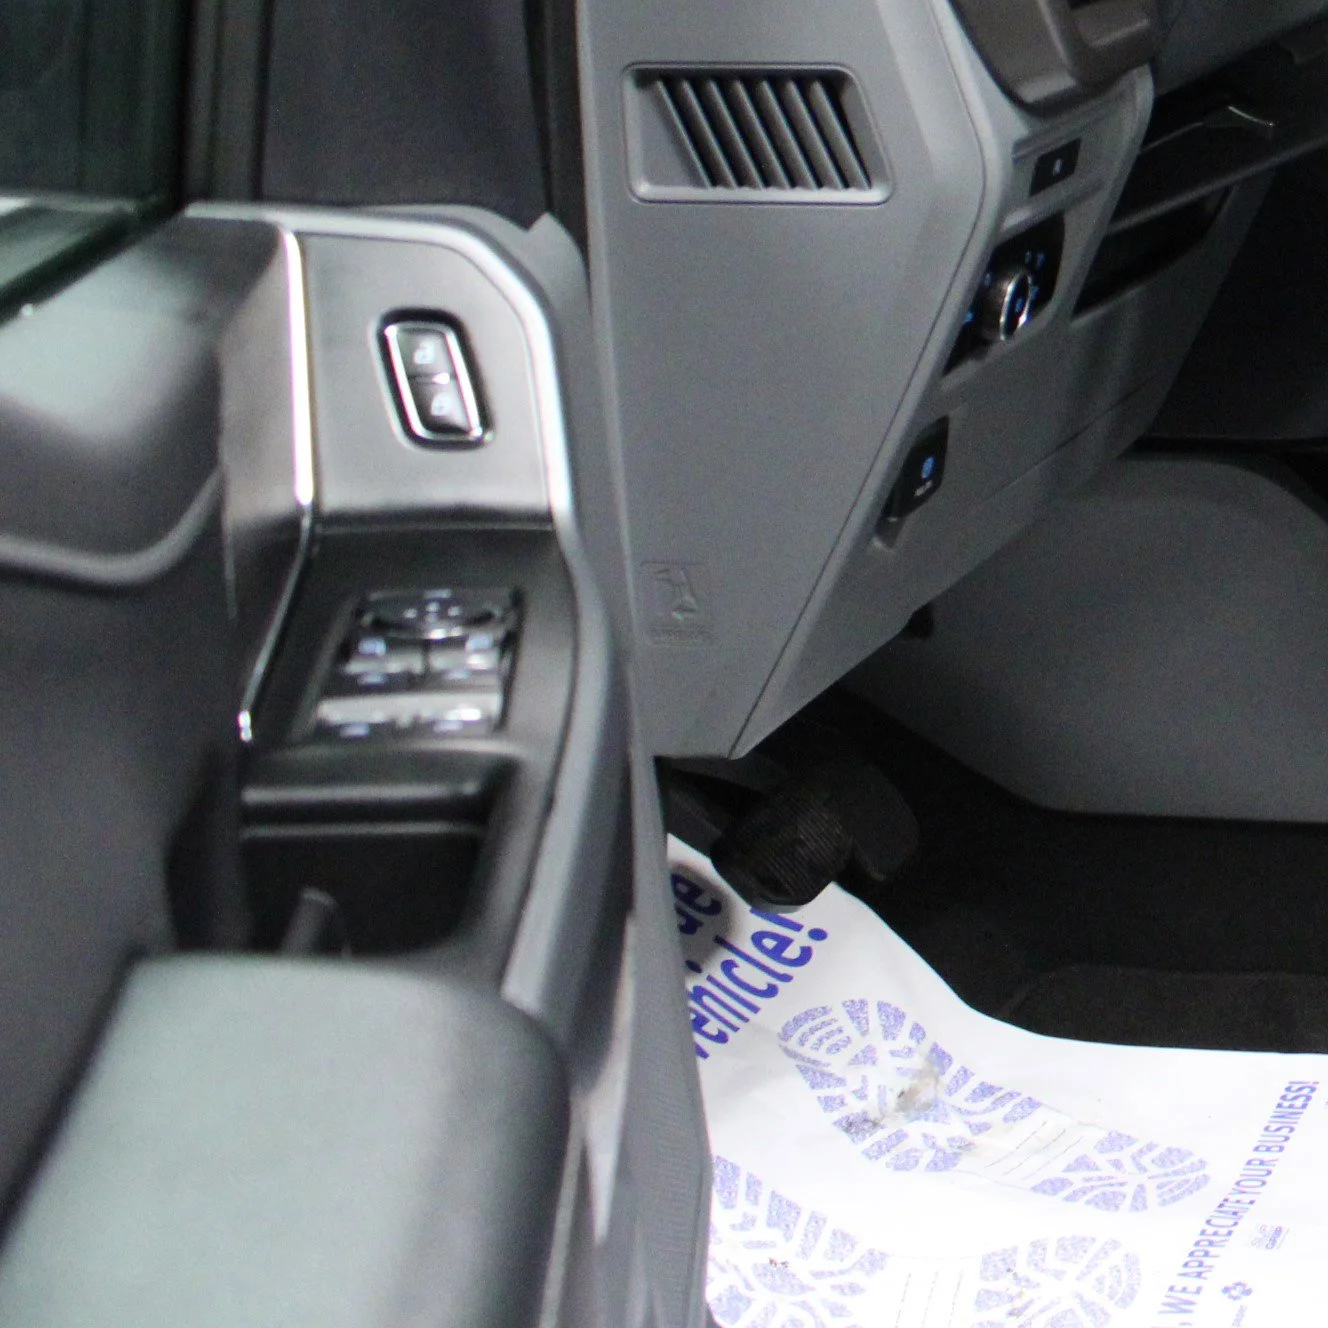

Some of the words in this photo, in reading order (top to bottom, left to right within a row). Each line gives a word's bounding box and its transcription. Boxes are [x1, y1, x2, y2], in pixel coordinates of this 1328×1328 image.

[685, 907, 828, 1060] ehicle!
[1252, 1080, 1320, 1154] BUSINESS!
[1228, 1158, 1280, 1196] YOUR
[1176, 1197, 1256, 1281] APPRECIATE
[1157, 1284, 1204, 1315] WE
